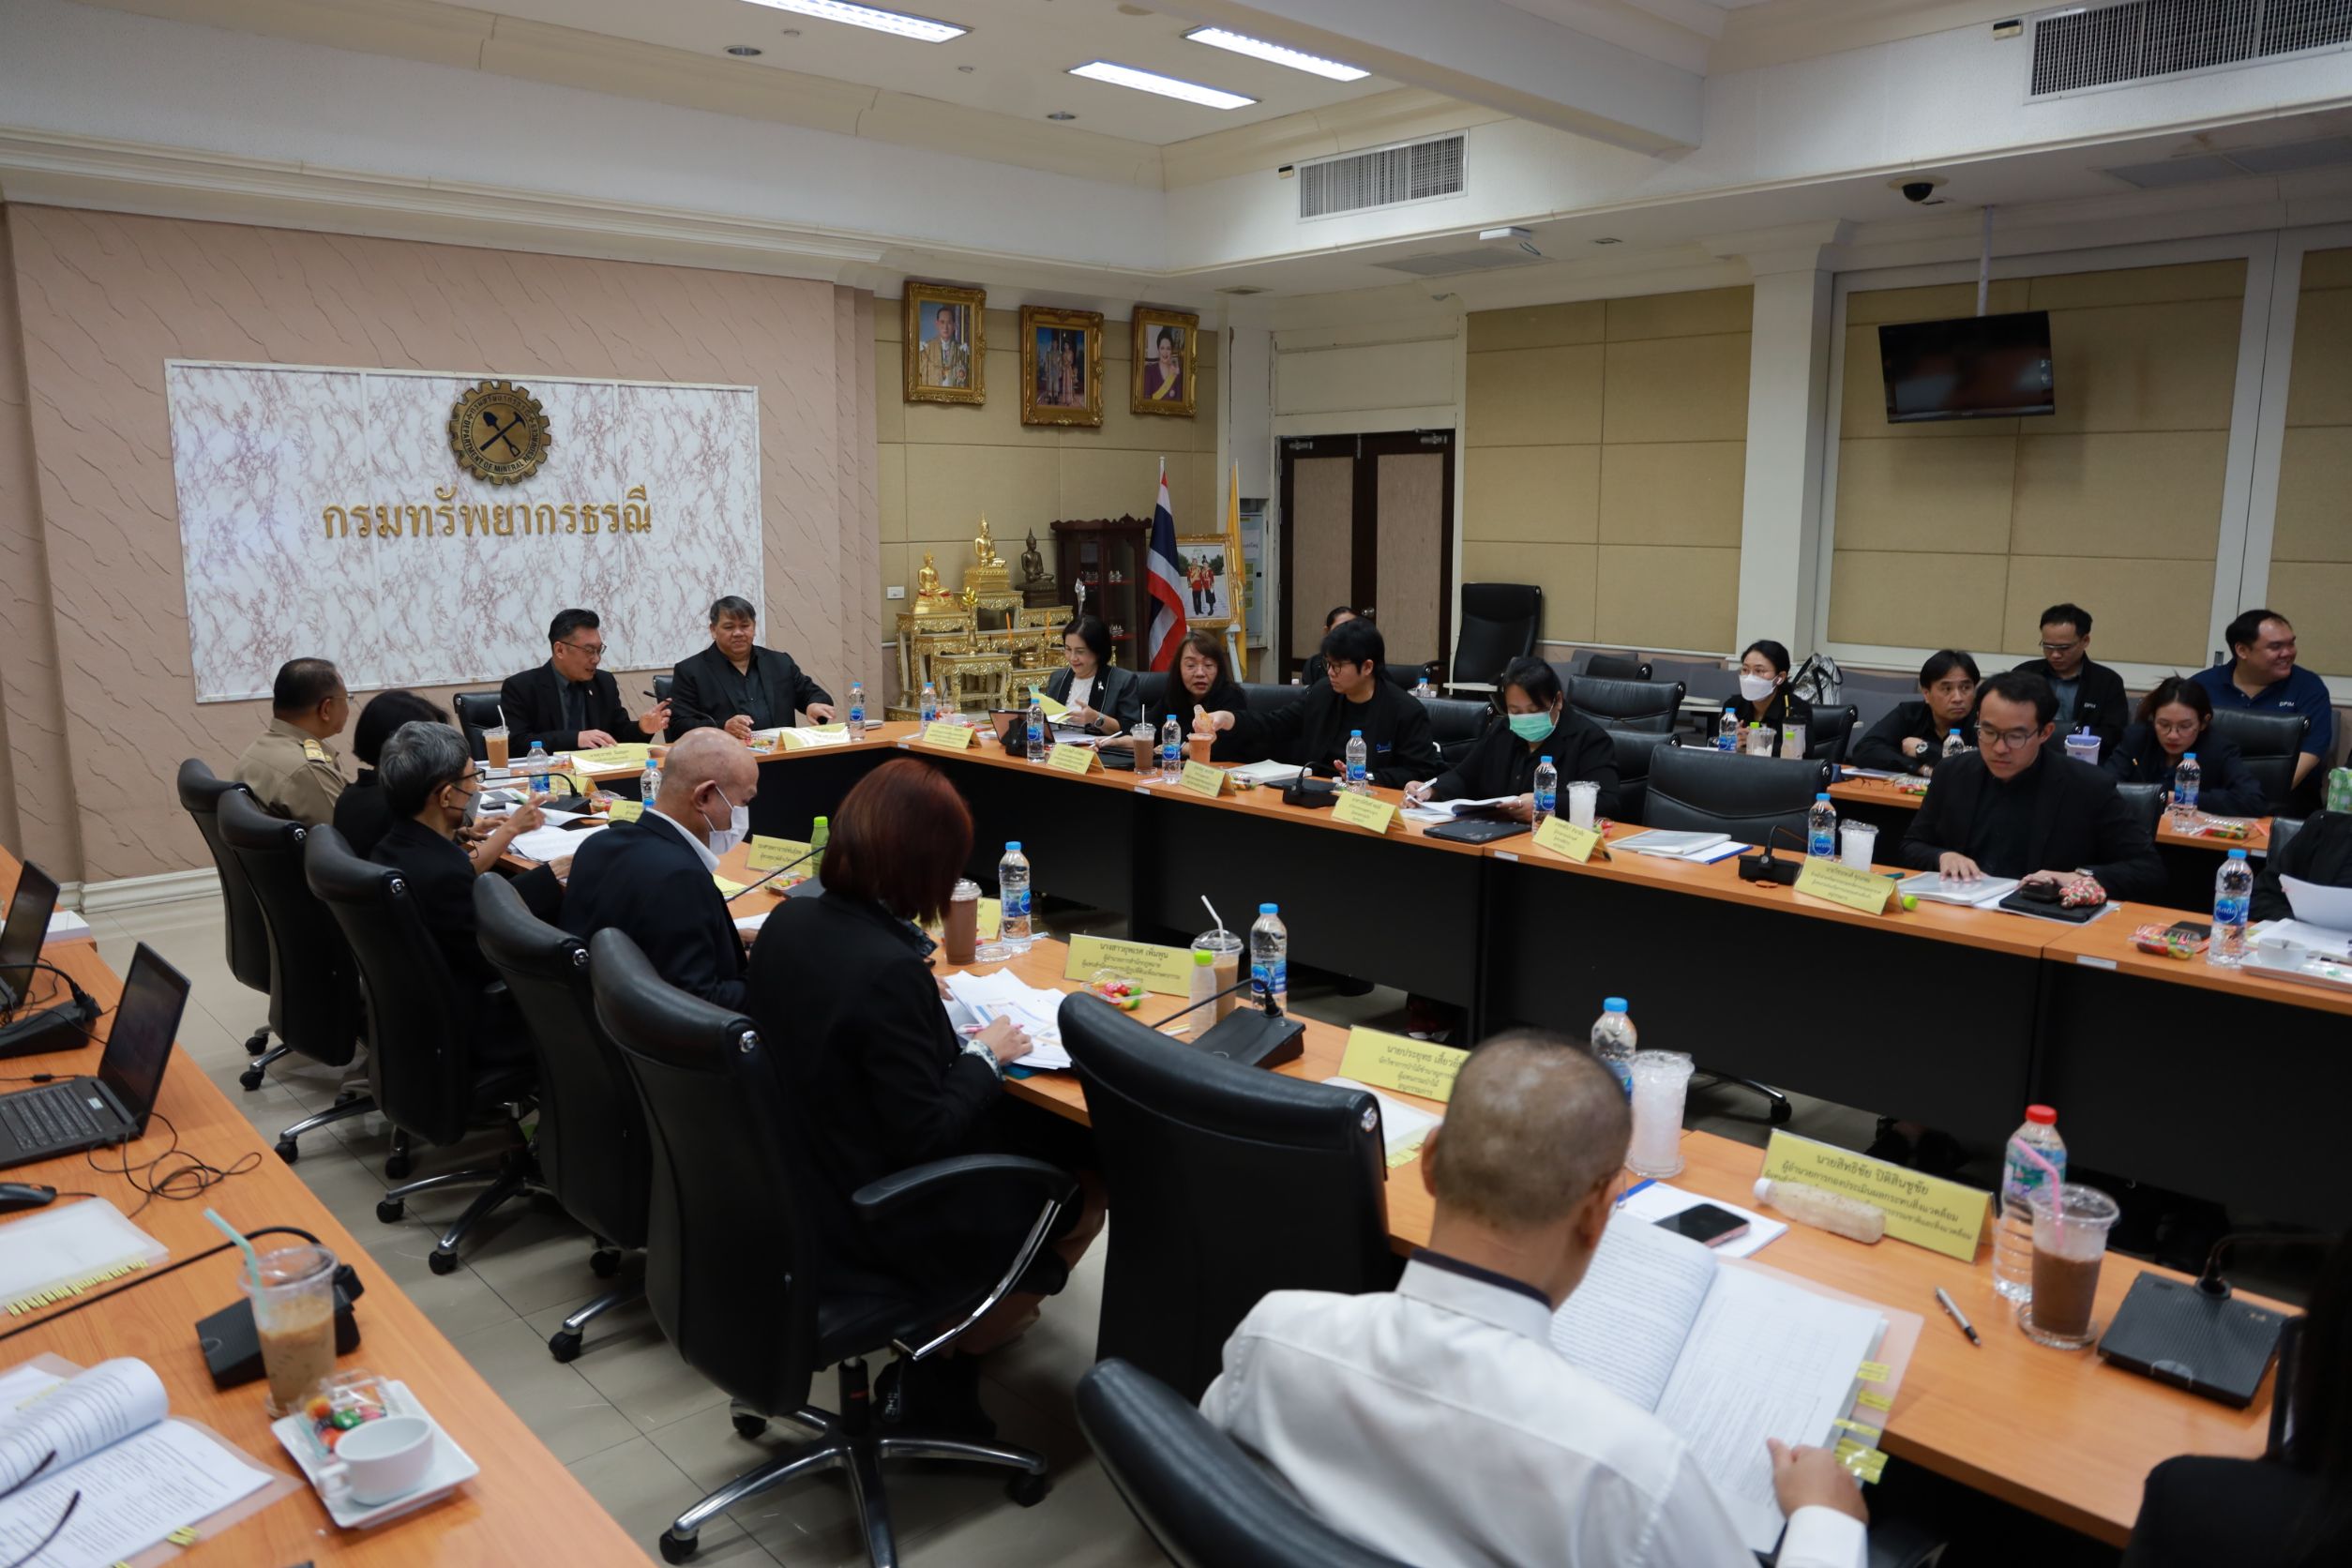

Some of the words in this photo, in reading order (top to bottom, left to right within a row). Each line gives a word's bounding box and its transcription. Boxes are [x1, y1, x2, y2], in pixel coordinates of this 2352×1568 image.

[462, 419, 484, 465] DEPARTMENT
[483, 461, 492, 470] OF
[493, 460, 524, 473] MINERAL
[524, 424, 539, 464] RESOURCES
[323, 483, 653, 539] กรมทรัพยากรธรณี
